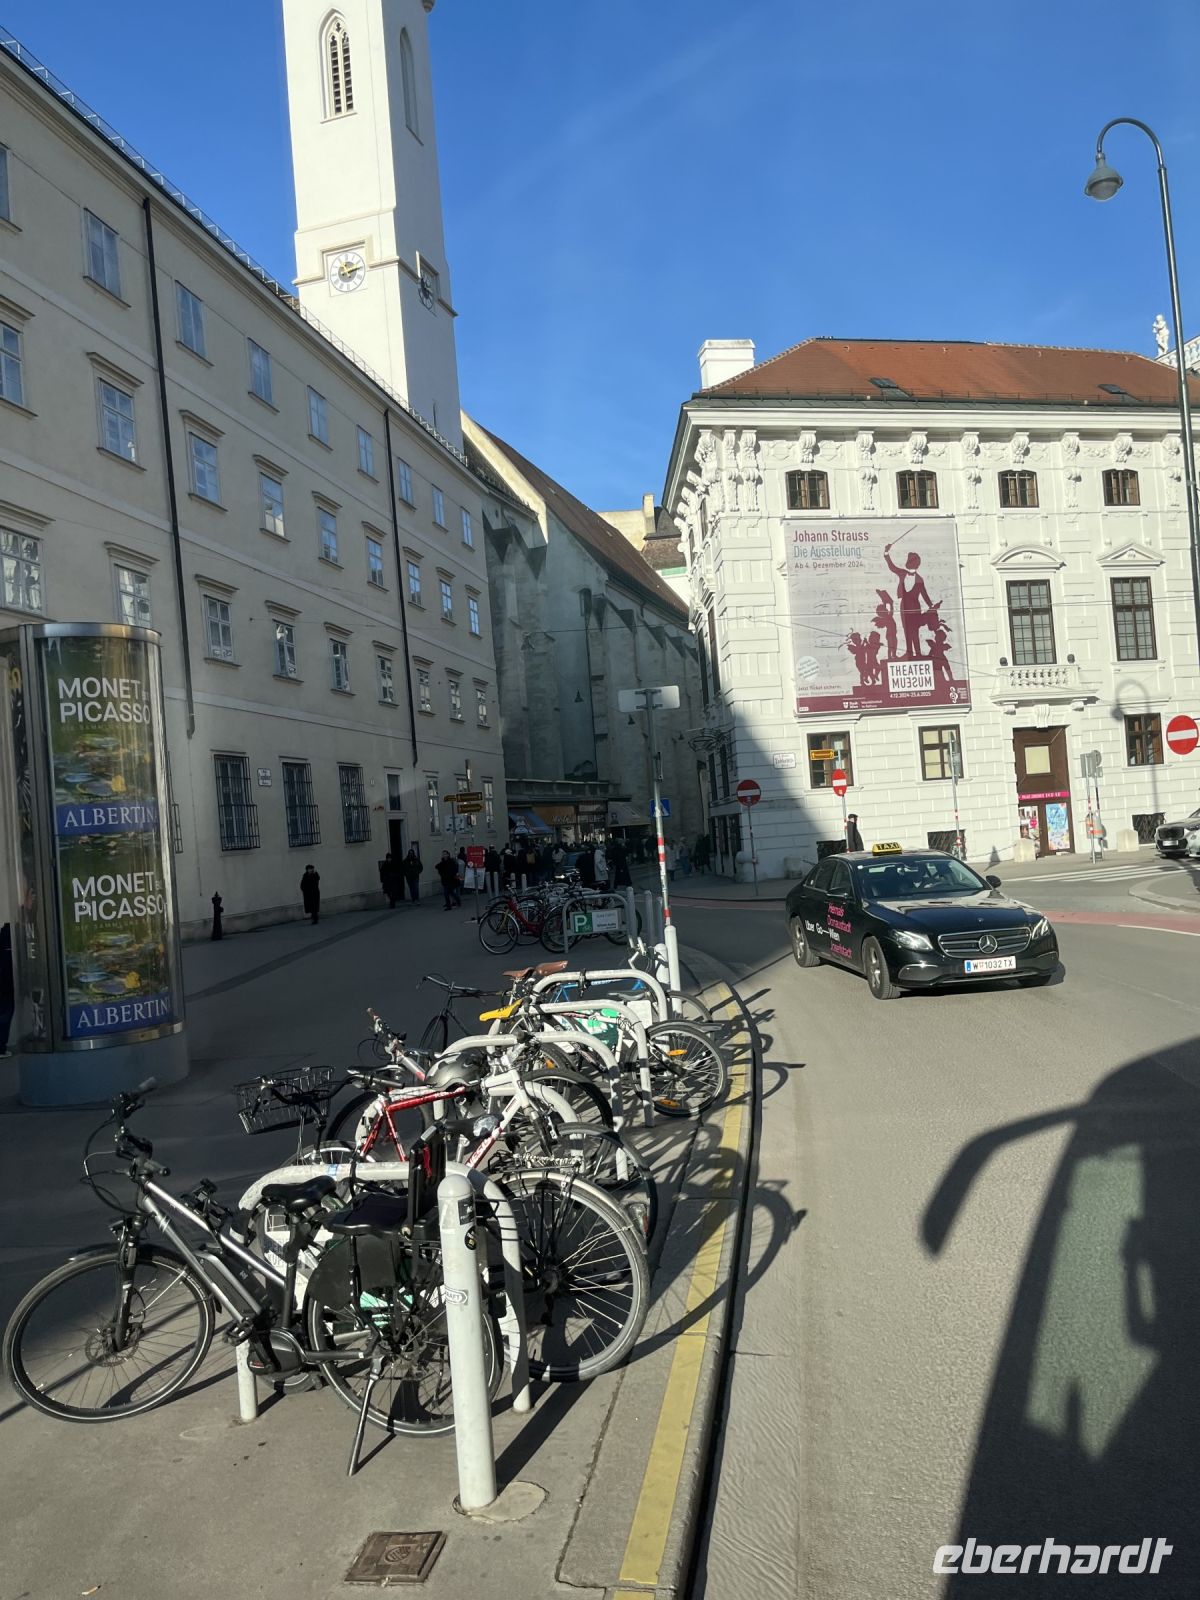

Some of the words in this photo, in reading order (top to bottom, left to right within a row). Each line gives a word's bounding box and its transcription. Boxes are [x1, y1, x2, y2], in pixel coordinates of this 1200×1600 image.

[793, 530, 829, 542] Johann
[831, 529, 869, 542] Strauss
[793, 545, 808, 558] Die
[810, 545, 862, 559] Ausstellung
[812, 561, 846, 569] Dezember
[889, 663, 931, 676] THEATER
[58, 677, 141, 699] MONET
[60, 701, 151, 724] PICASSO
[64, 806, 157, 828] ALBERTIN
[876, 842, 900, 851] TAXI
[72, 871, 155, 898] MONET
[74, 894, 164, 922] PICASSO
[574, 915, 587, 932] P
[77, 997, 169, 1028] ALBERTIN
